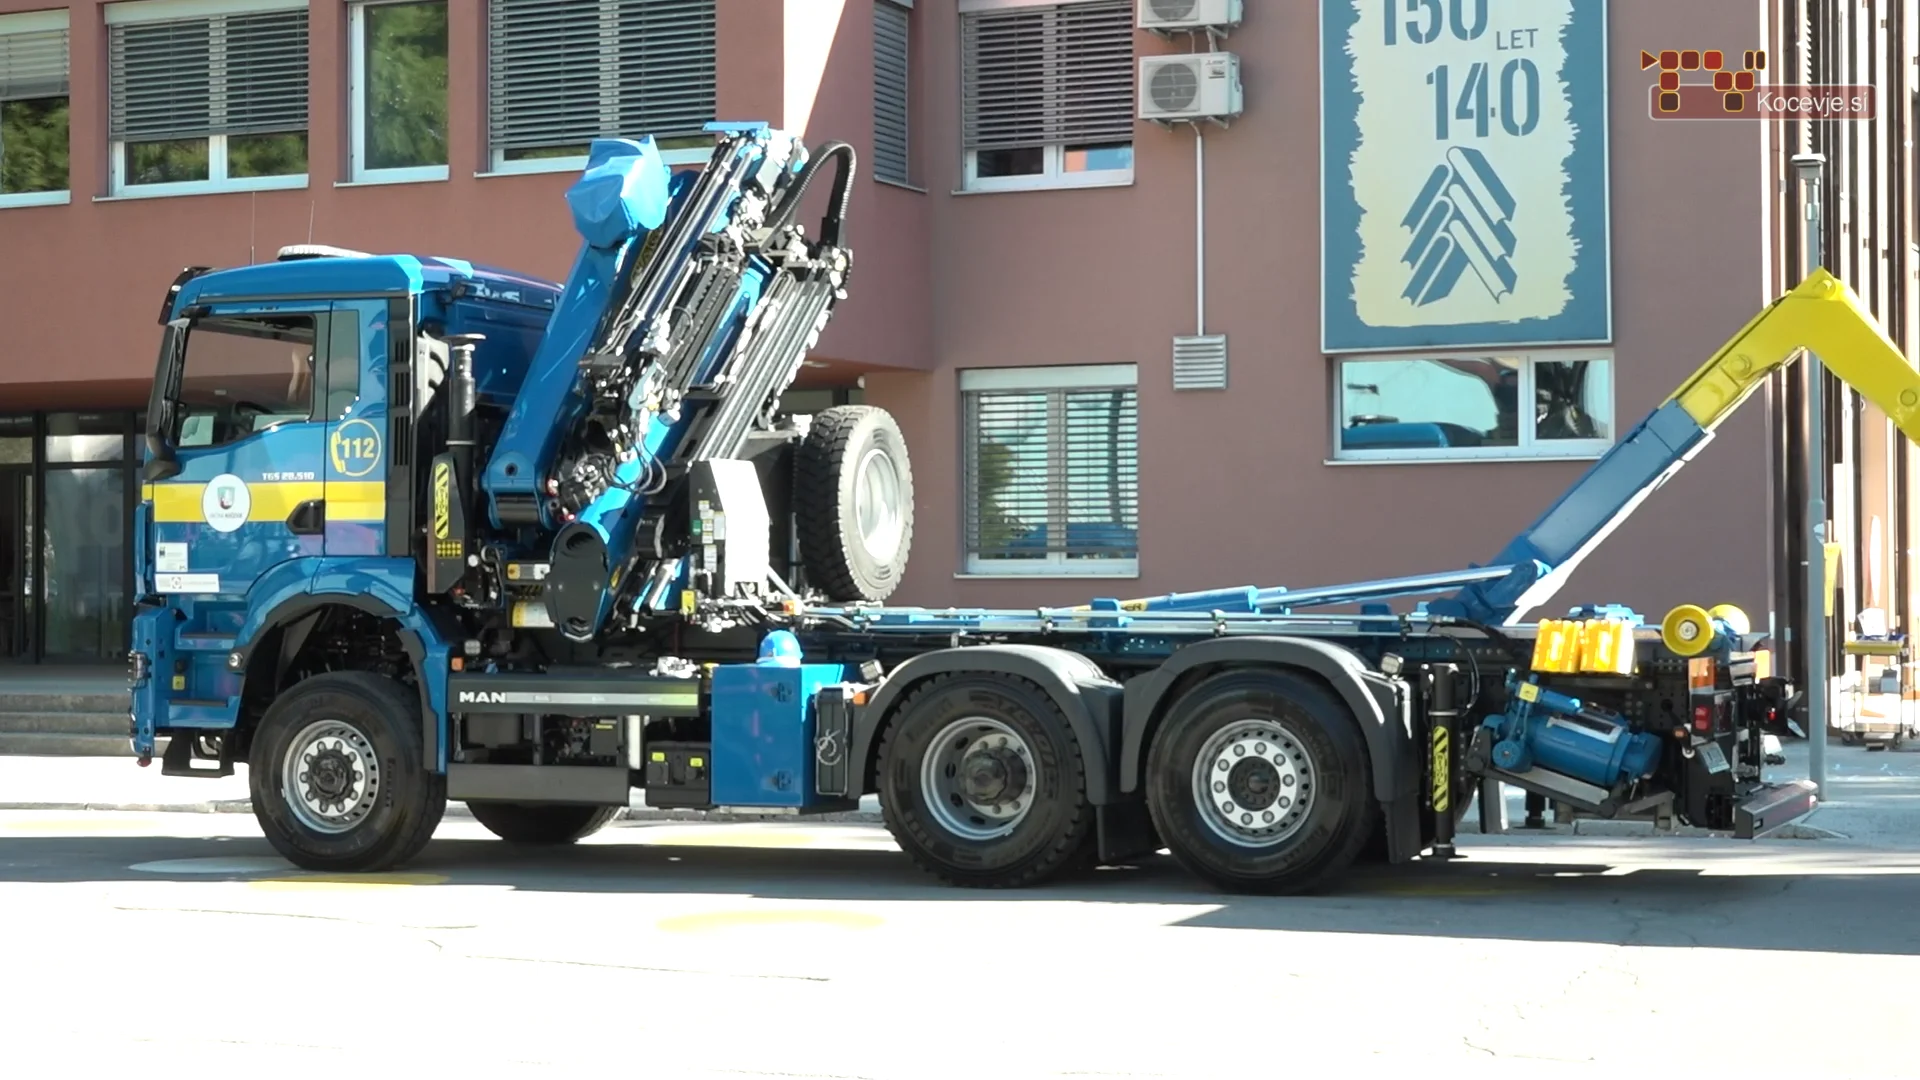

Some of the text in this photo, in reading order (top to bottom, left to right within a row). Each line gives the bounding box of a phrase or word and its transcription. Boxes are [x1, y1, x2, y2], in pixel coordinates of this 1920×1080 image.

[1384, 0, 1539, 51] 150 LET
[1426, 58, 1540, 140] 140
[341, 437, 375, 459] 112
[262, 471, 315, 481] TGS 28.510
[459, 691, 506, 703] MAN
